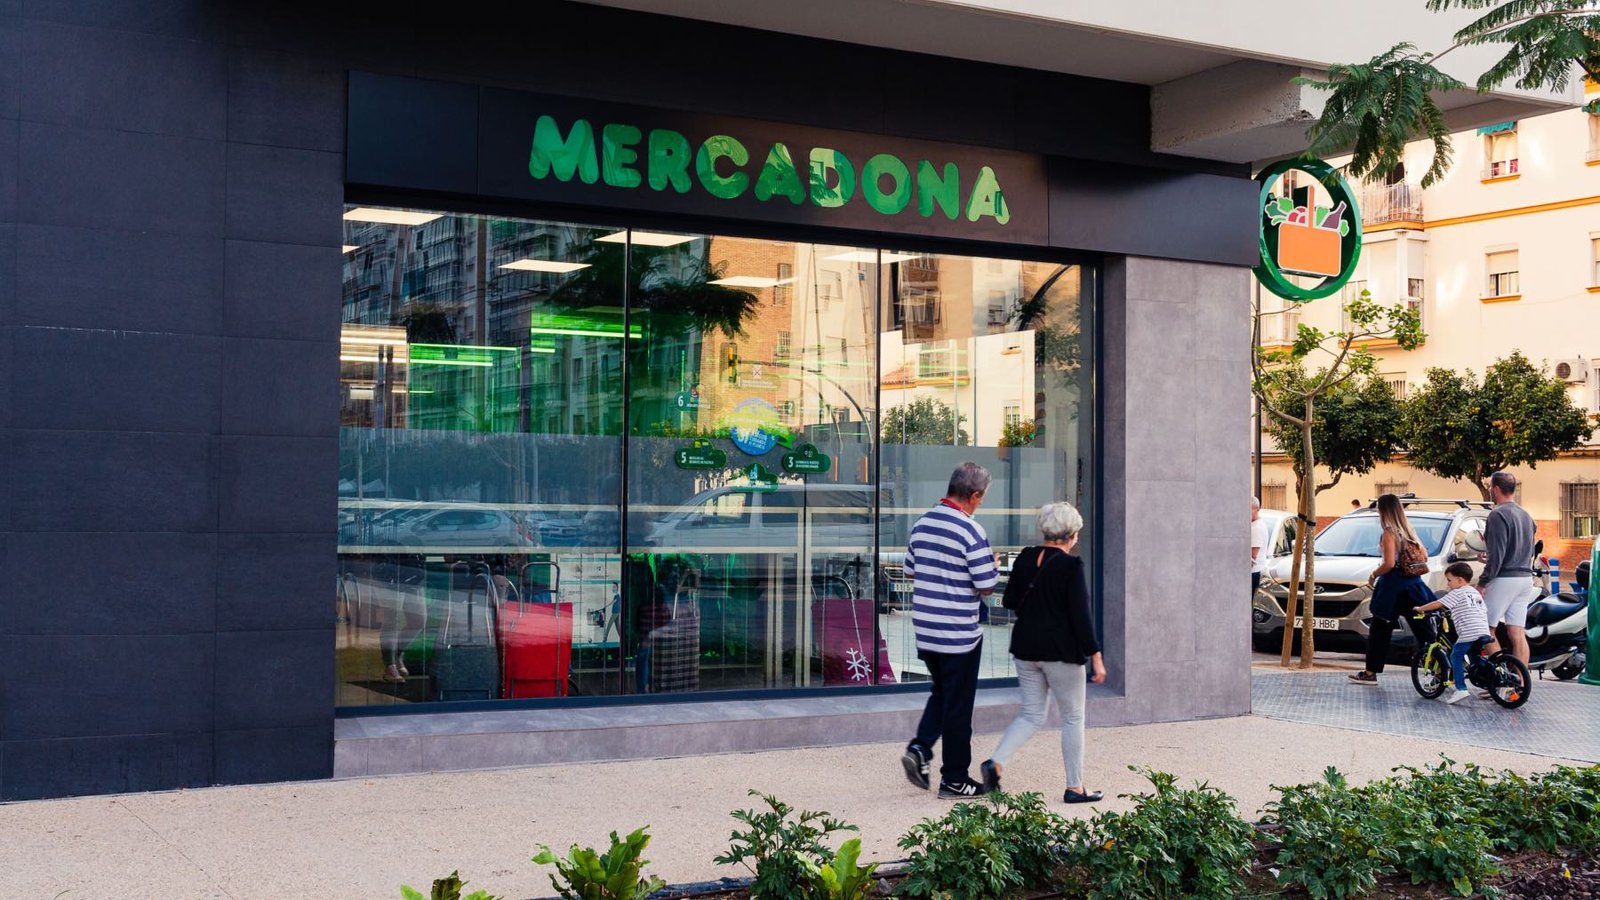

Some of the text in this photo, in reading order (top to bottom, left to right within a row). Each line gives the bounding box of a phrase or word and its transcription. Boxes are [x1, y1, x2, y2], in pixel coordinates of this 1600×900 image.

[528, 115, 1010, 225] MERCADONA
[677, 395, 684, 407] 6
[681, 452, 687, 464] 5
[788, 456, 794, 468] 3
[1319, 619, 1335, 629] HBG
